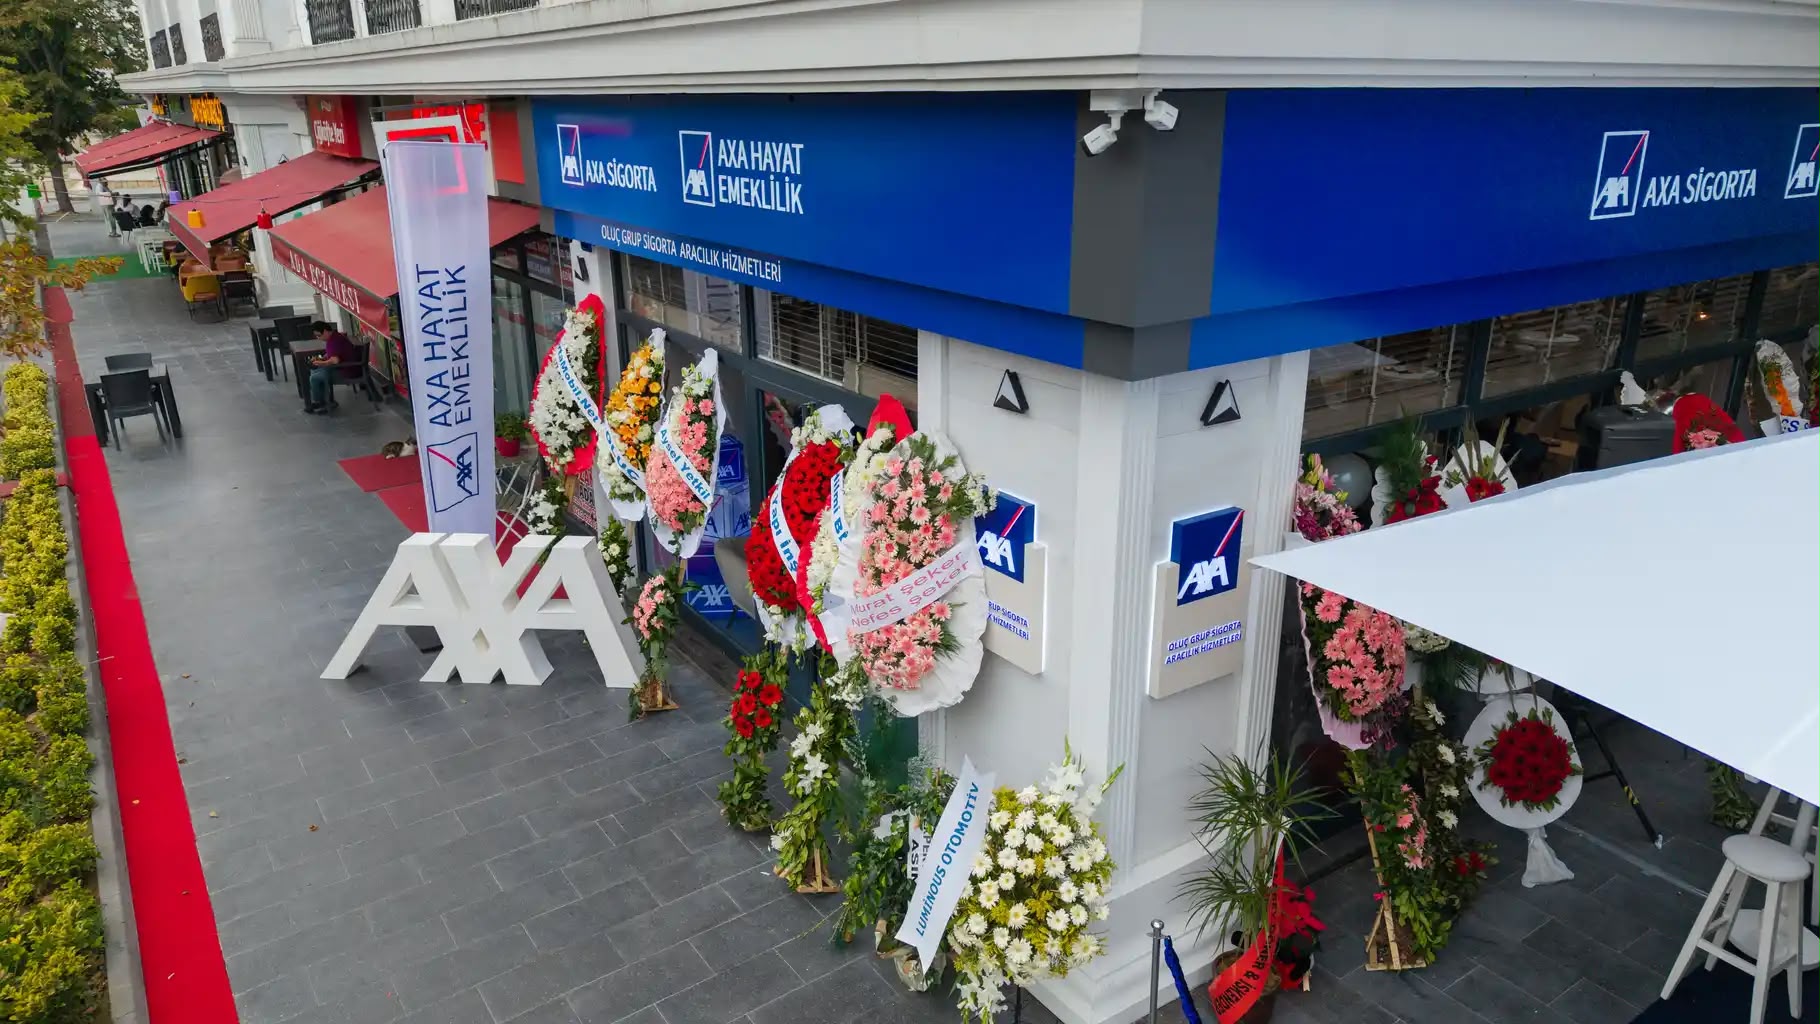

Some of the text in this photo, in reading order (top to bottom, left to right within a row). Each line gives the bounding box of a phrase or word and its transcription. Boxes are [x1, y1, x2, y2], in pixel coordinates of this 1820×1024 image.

[586, 157, 657, 192] AXA SİGORTA
[718, 138, 804, 175] AXA HAYAT
[718, 174, 804, 215] EMEKLİLİK
[1642, 166, 1757, 208] AXA SİGORTA
[601, 224, 782, 283] OLUÇ GRUP SİGORTA ARACILIK HİZMETLERİ
[416, 263, 453, 427] AXA HAYAT
[442, 264, 471, 425] EMEKLİLİK
[660, 428, 681, 463] Aysel
[320, 531, 646, 689] AXA
[850, 592, 895, 616] Murat
[851, 605, 902, 628] Nefes
[1001, 607, 1029, 629] SİGORTA
[1190, 630, 1211, 645] GRUP
[1211, 620, 1242, 637] SİGORTA
[1165, 646, 1200, 665] ARACILIK
[915, 782, 980, 937] LUMİNOUS OTOMOTİV
